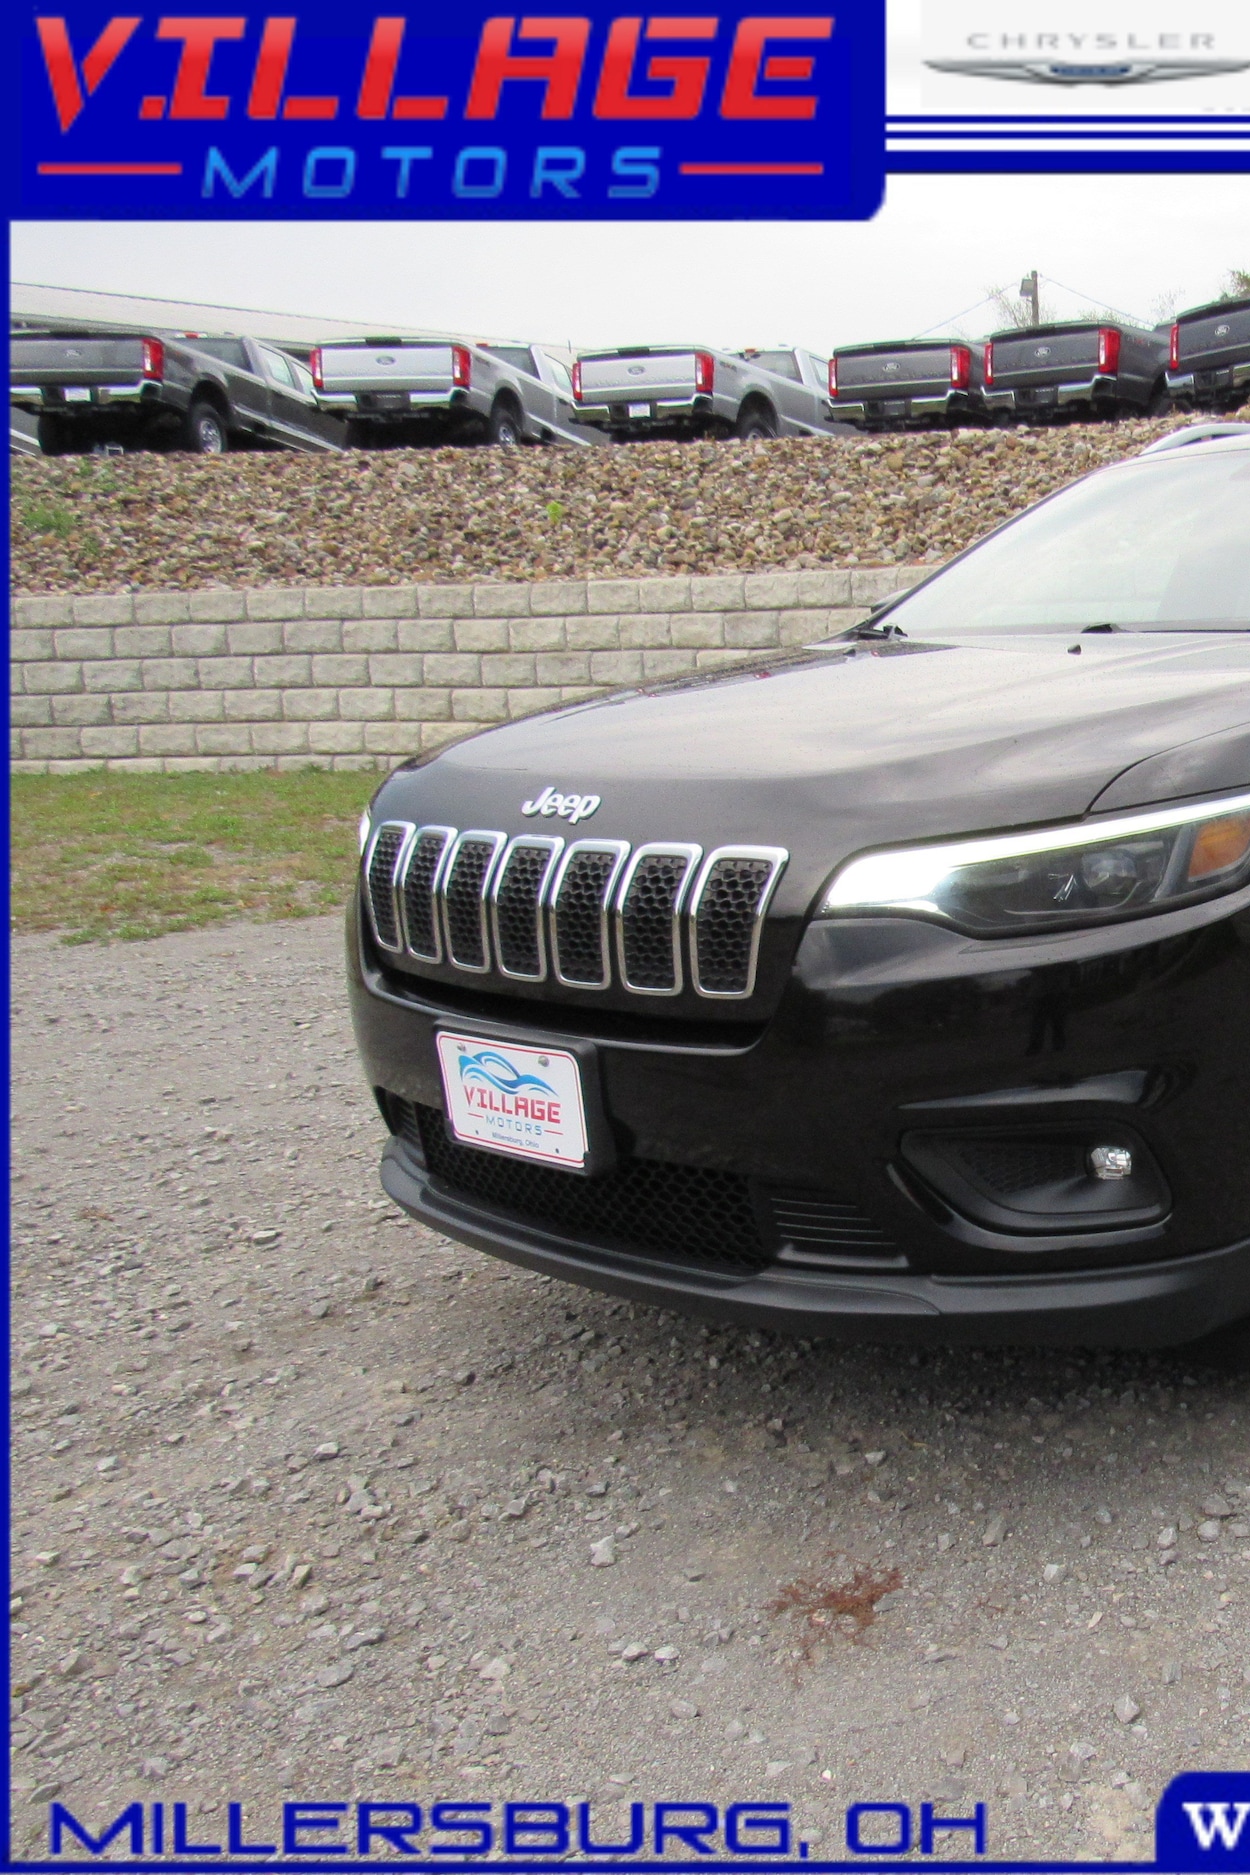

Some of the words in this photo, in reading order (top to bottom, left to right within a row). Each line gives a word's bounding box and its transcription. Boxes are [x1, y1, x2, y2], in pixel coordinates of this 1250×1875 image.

[521, 786, 602, 825] Jeep
[463, 1085, 561, 1124] VILLAGE
[486, 1115, 543, 1136] MOTORS
